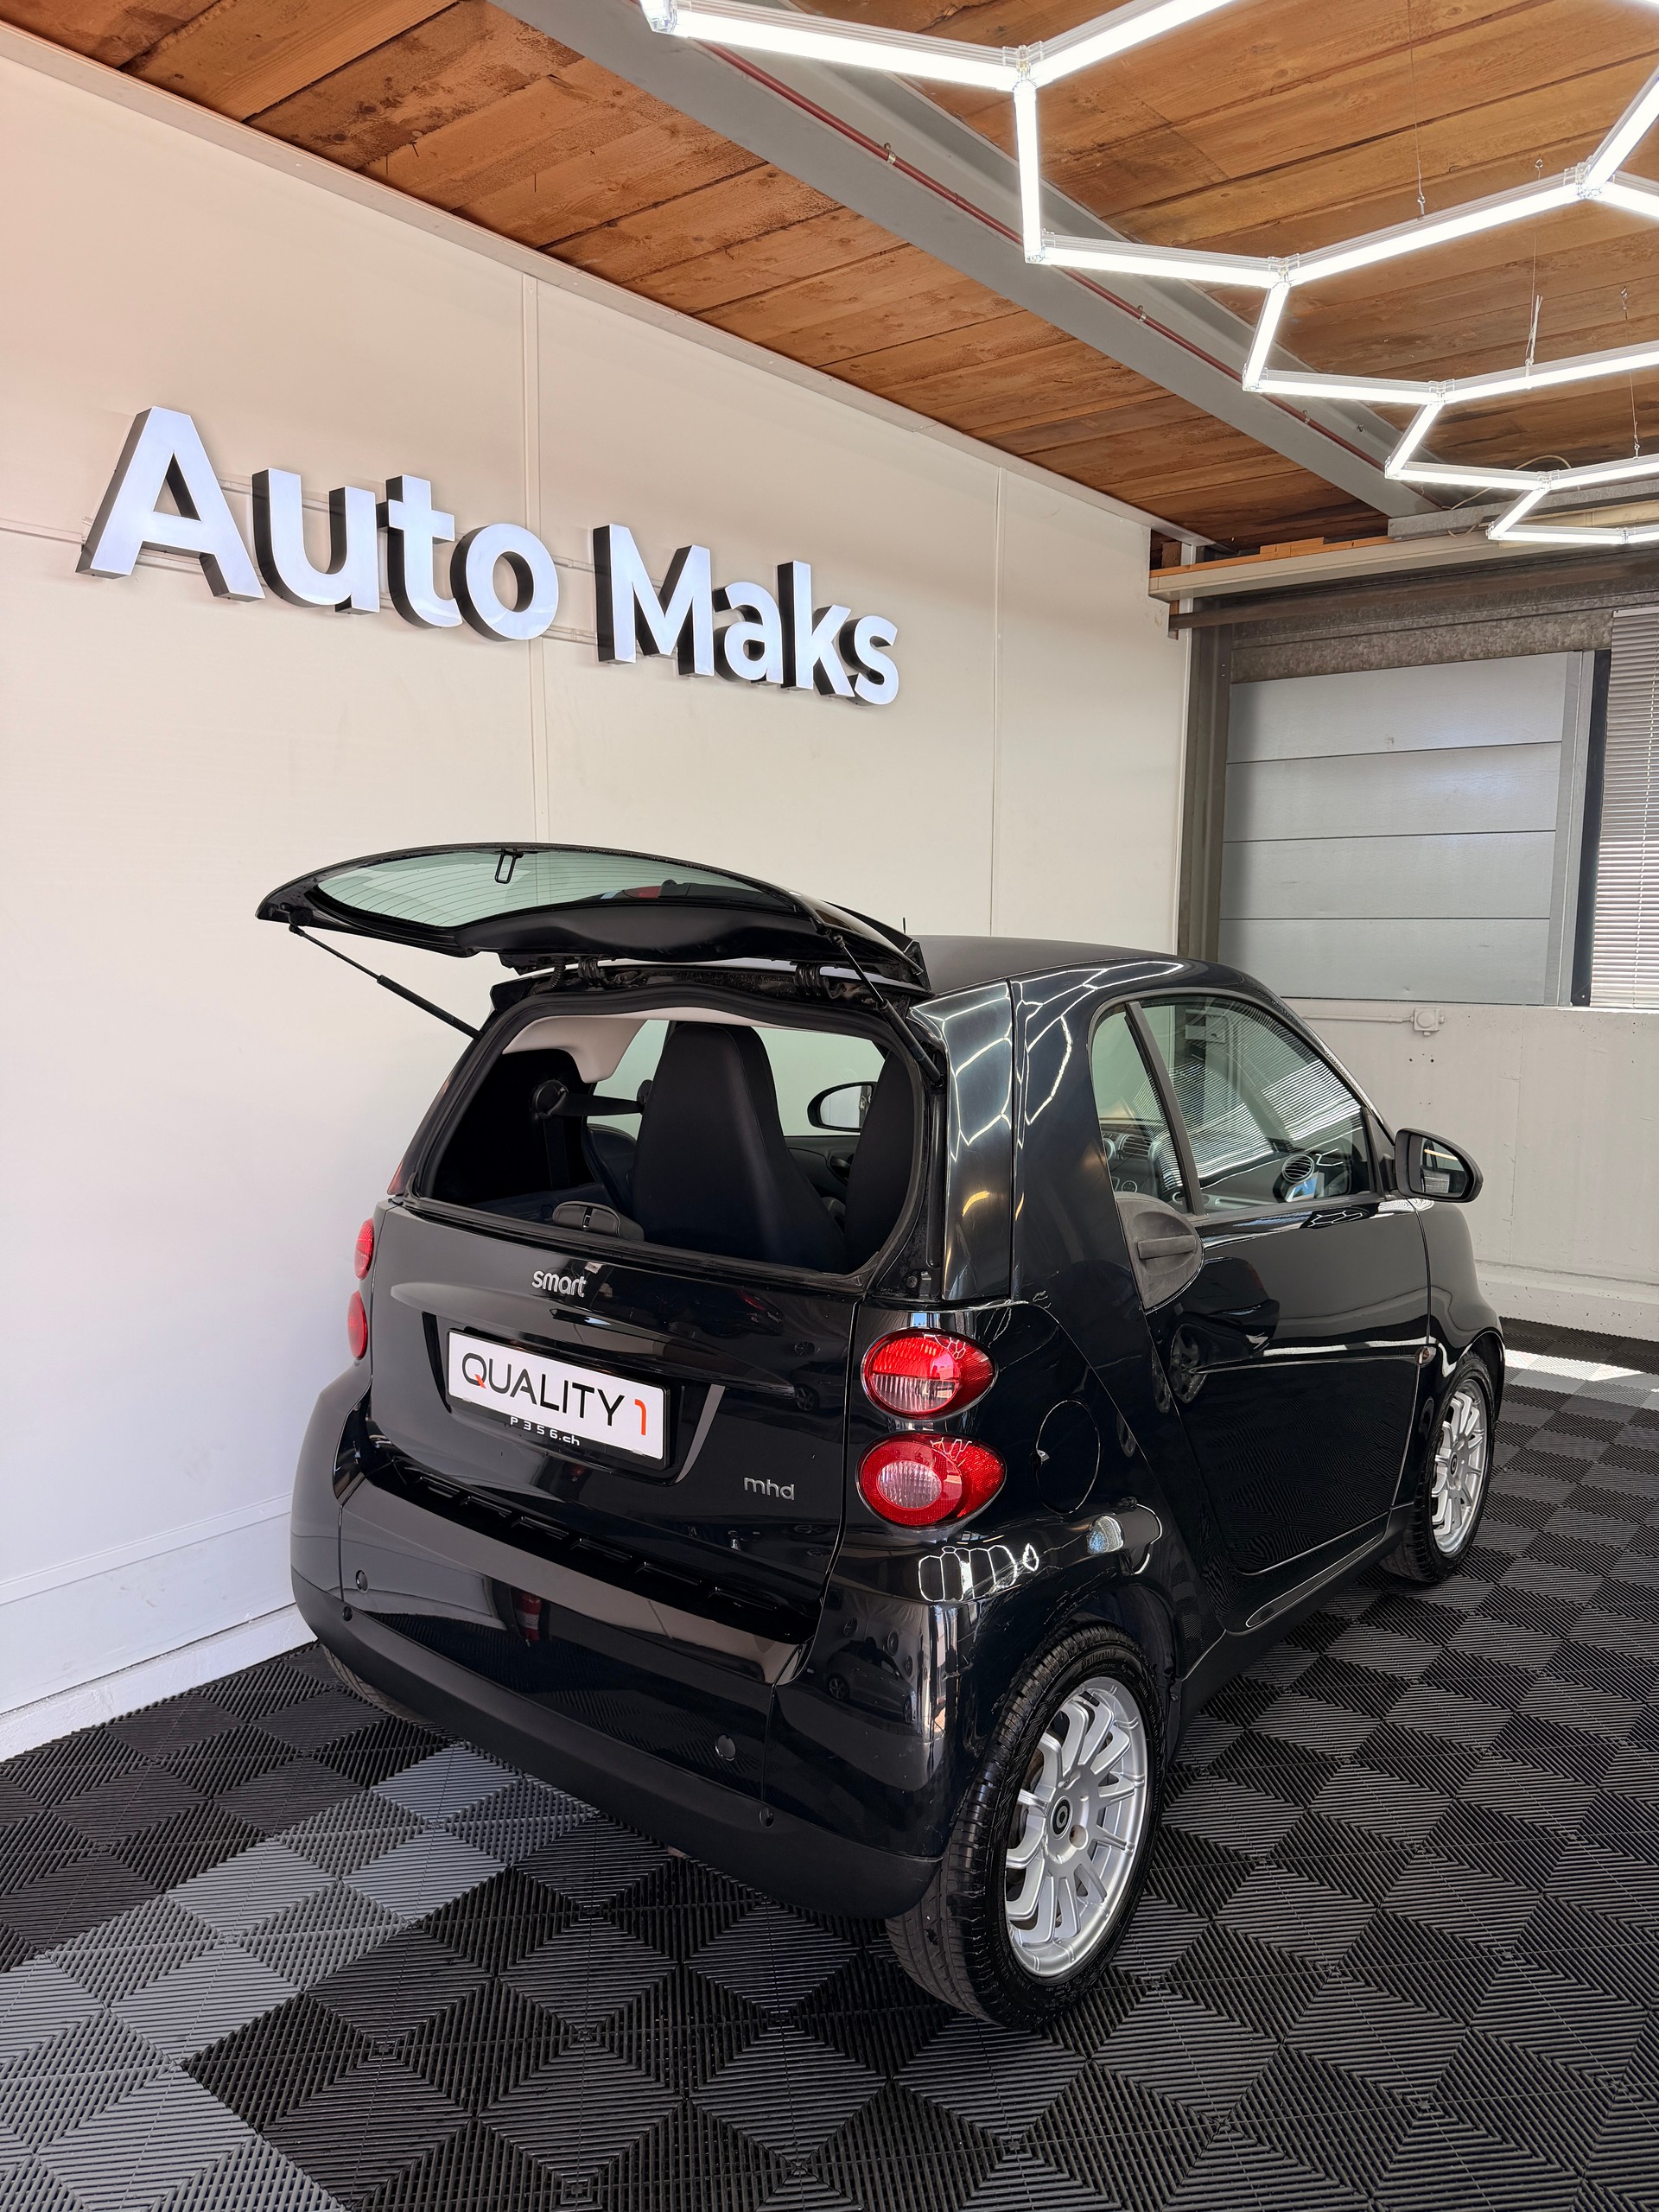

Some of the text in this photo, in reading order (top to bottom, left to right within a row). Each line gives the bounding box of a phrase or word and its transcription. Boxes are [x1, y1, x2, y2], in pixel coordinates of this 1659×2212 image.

[76, 405, 899, 706] Auto Maks
[531, 1270, 587, 1298] smart
[461, 1352, 625, 1427] QUALITY
[744, 1477, 794, 1501] mhd
